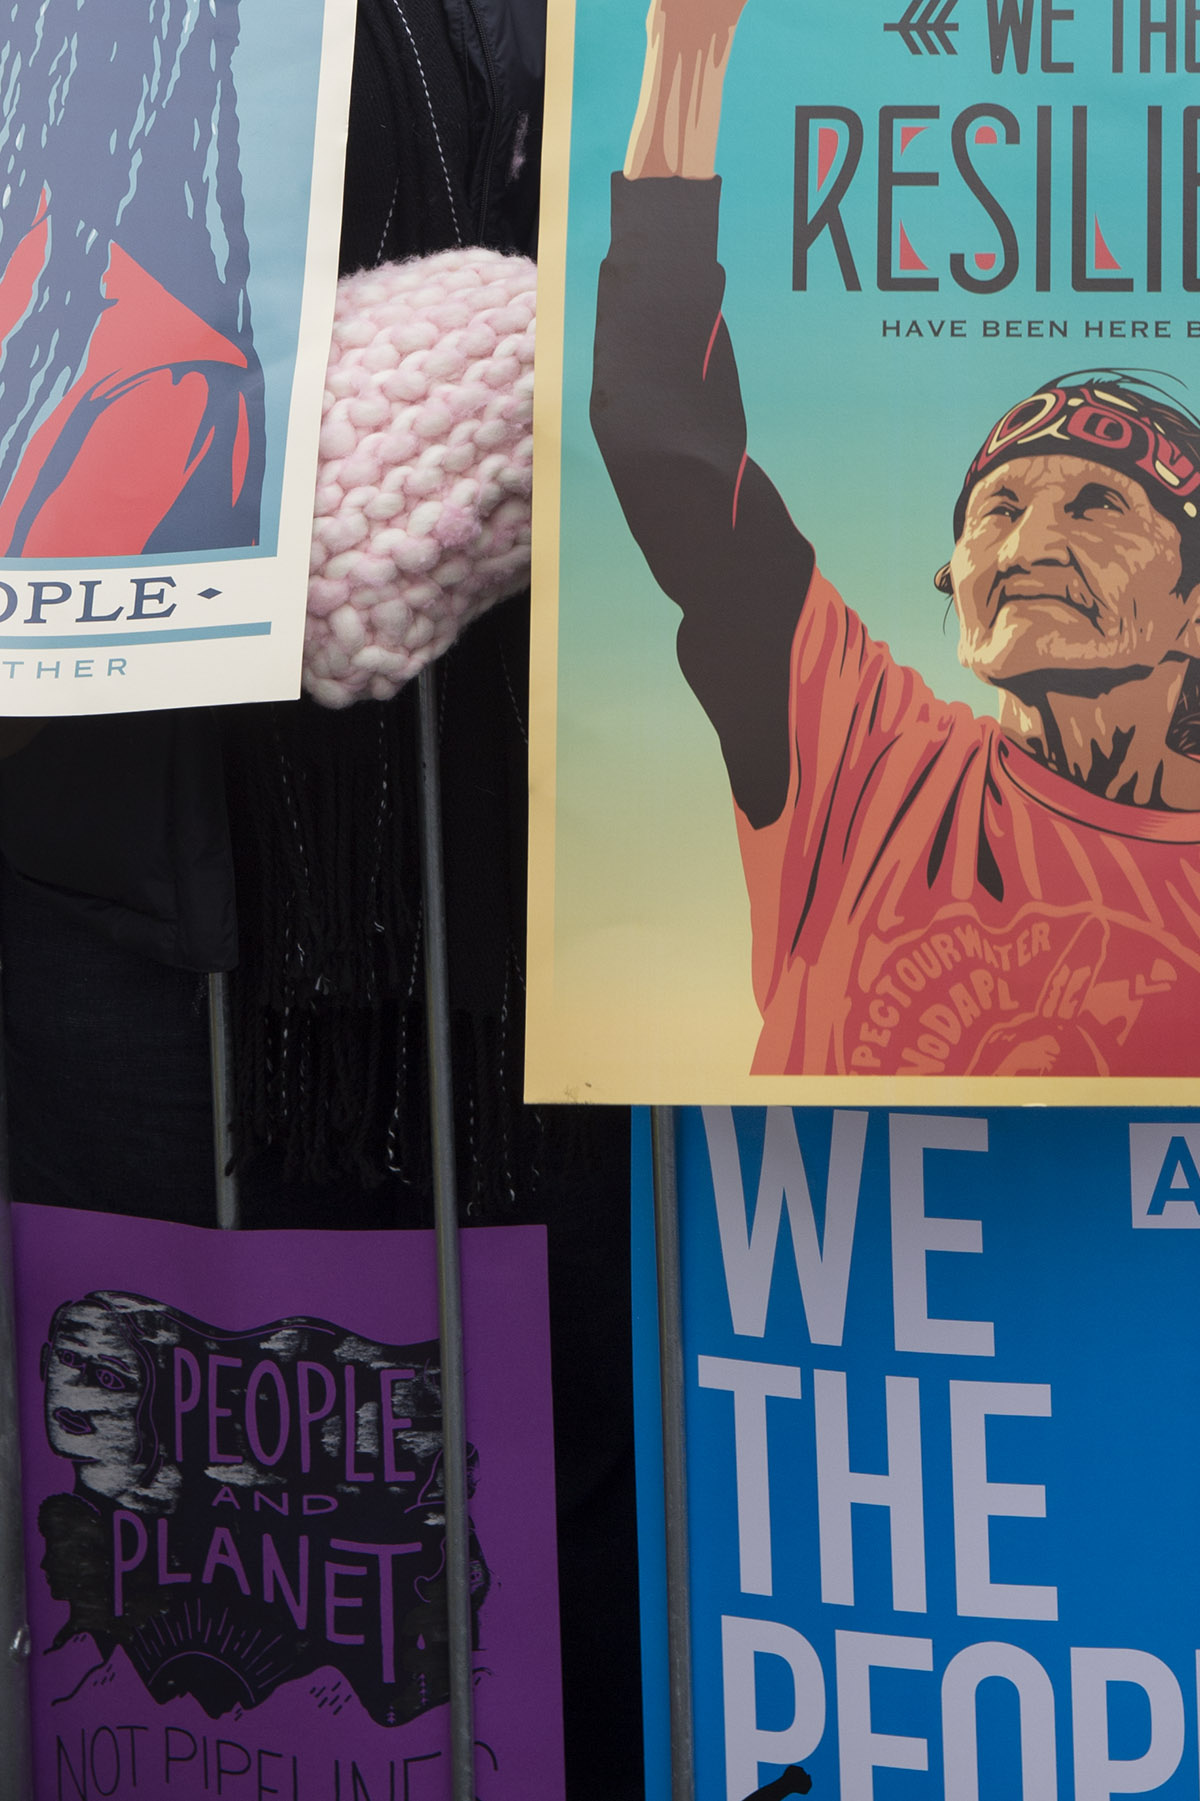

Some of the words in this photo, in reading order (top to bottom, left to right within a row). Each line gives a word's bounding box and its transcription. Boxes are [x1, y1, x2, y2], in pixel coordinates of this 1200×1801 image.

[881, 319, 968, 338] HAVE
[982, 319, 1068, 338] BEEN
[1084, 320, 1171, 338] HERE
[702, 1106, 996, 1357] WE
[173, 1346, 416, 1482] PEOPLE
[211, 1487, 338, 1516] AND
[698, 1354, 1059, 1622] THE
[113, 1508, 423, 1684] PLANET
[56, 1725, 149, 1801] NOT
